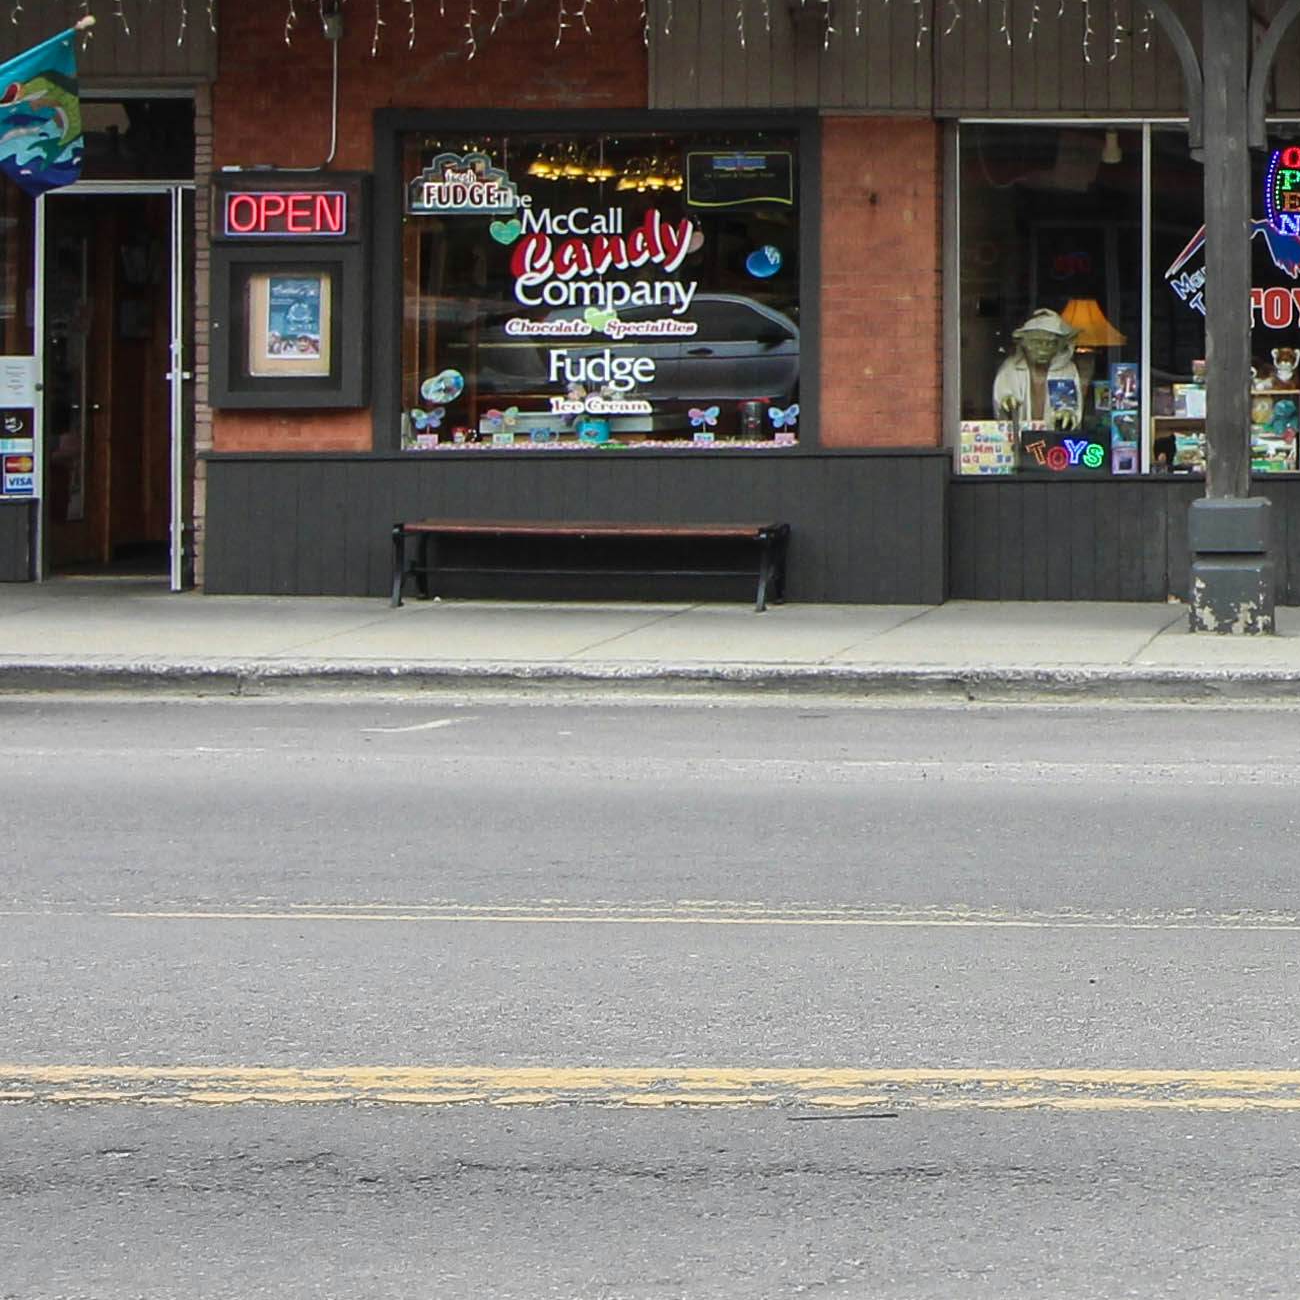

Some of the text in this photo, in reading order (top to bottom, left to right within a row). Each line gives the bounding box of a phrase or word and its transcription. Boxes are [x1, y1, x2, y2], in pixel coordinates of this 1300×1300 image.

[423, 182, 499, 209] FUDGE
[229, 194, 342, 233] OPEN
[521, 207, 623, 235] McCall
[511, 208, 694, 286] Candy
[514, 271, 698, 315] Company
[505, 317, 698, 340] Chocolate Specialties
[549, 349, 656, 392] Fudge
[551, 397, 653, 414] Ice Cream
[1025, 438, 1105, 472] TOYS
[9, 477, 34, 487] VISA
